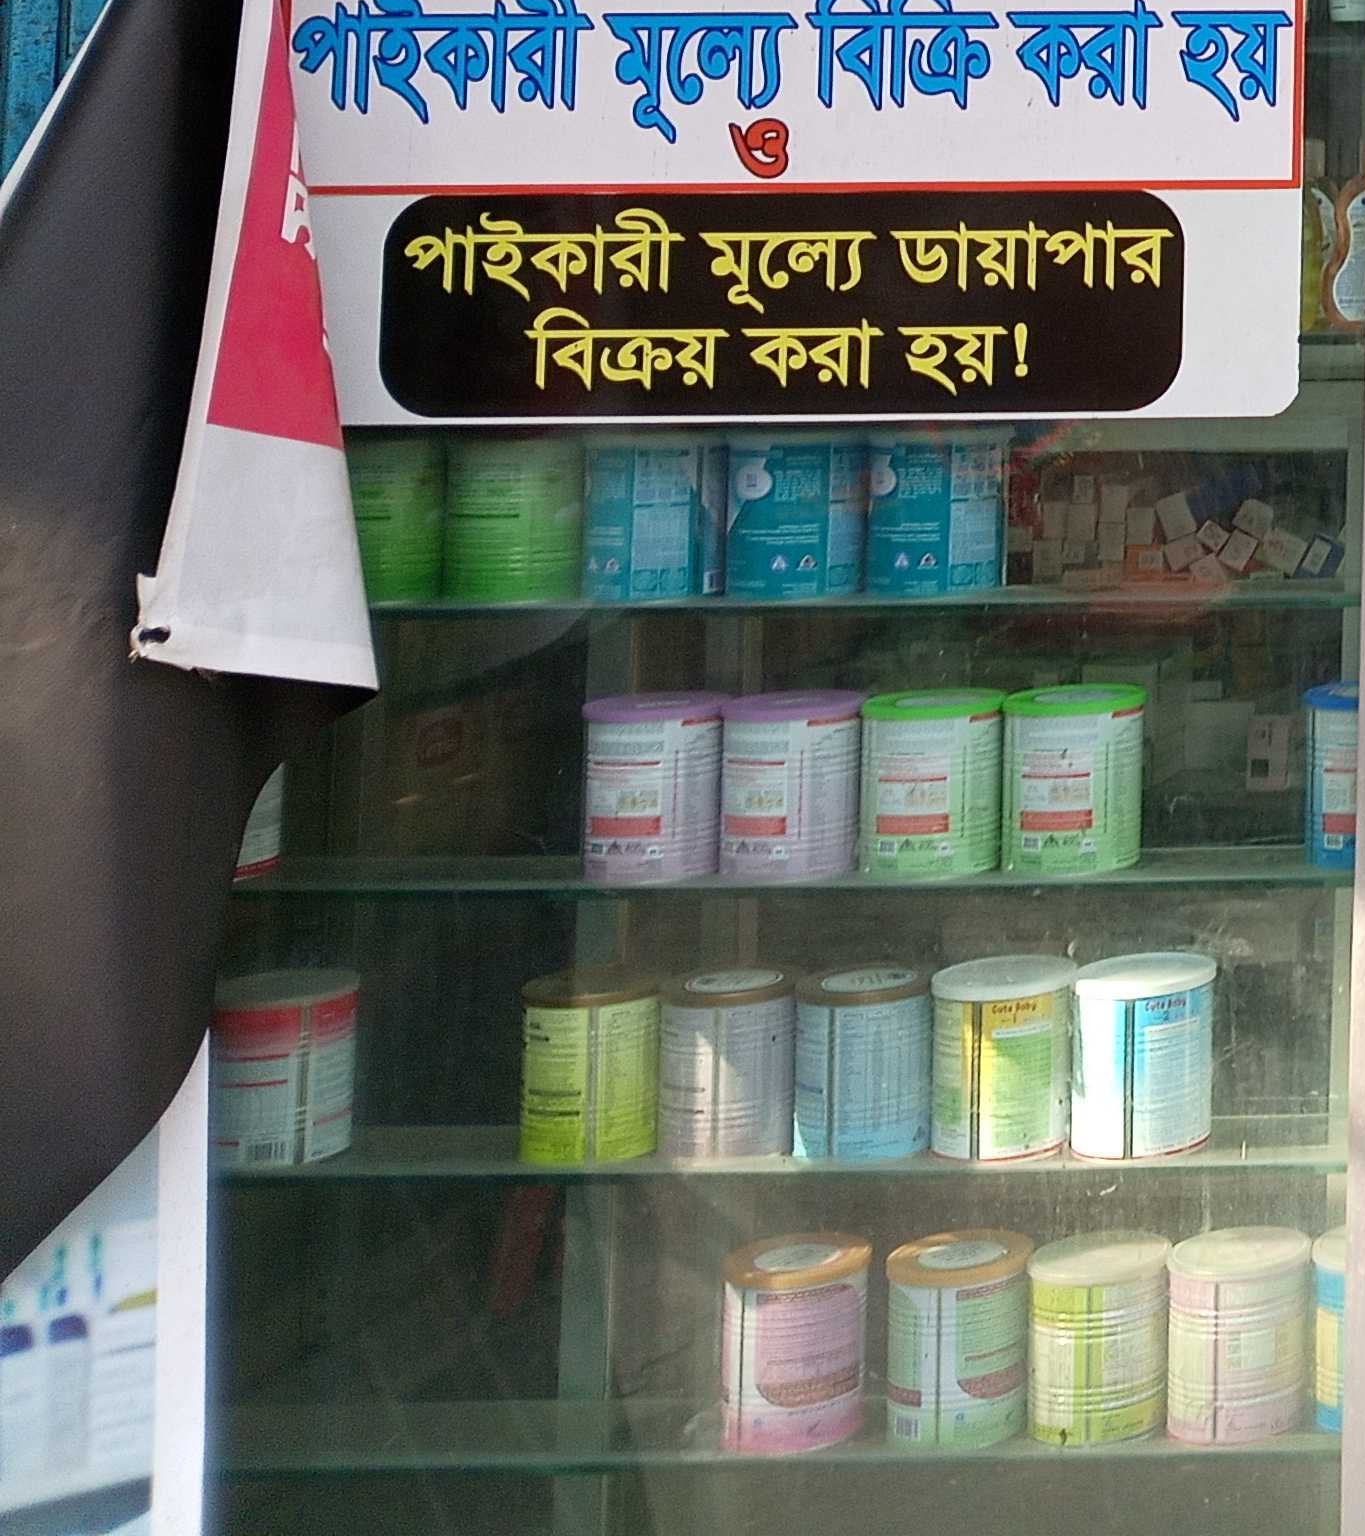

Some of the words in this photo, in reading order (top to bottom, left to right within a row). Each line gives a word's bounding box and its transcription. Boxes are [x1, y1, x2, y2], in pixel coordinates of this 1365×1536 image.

[605, 7, 800, 144] মূল্যে
[1173, 5, 1293, 123] হয়
[731, 116, 790, 180] ও
[403, 204, 685, 298] পাইকারী
[700, 225, 872, 308] মূল্যে
[891, 221, 1175, 292] ডায়াপার
[525, 306, 728, 391] বিক্রয়
[747, 317, 882, 385] করা
